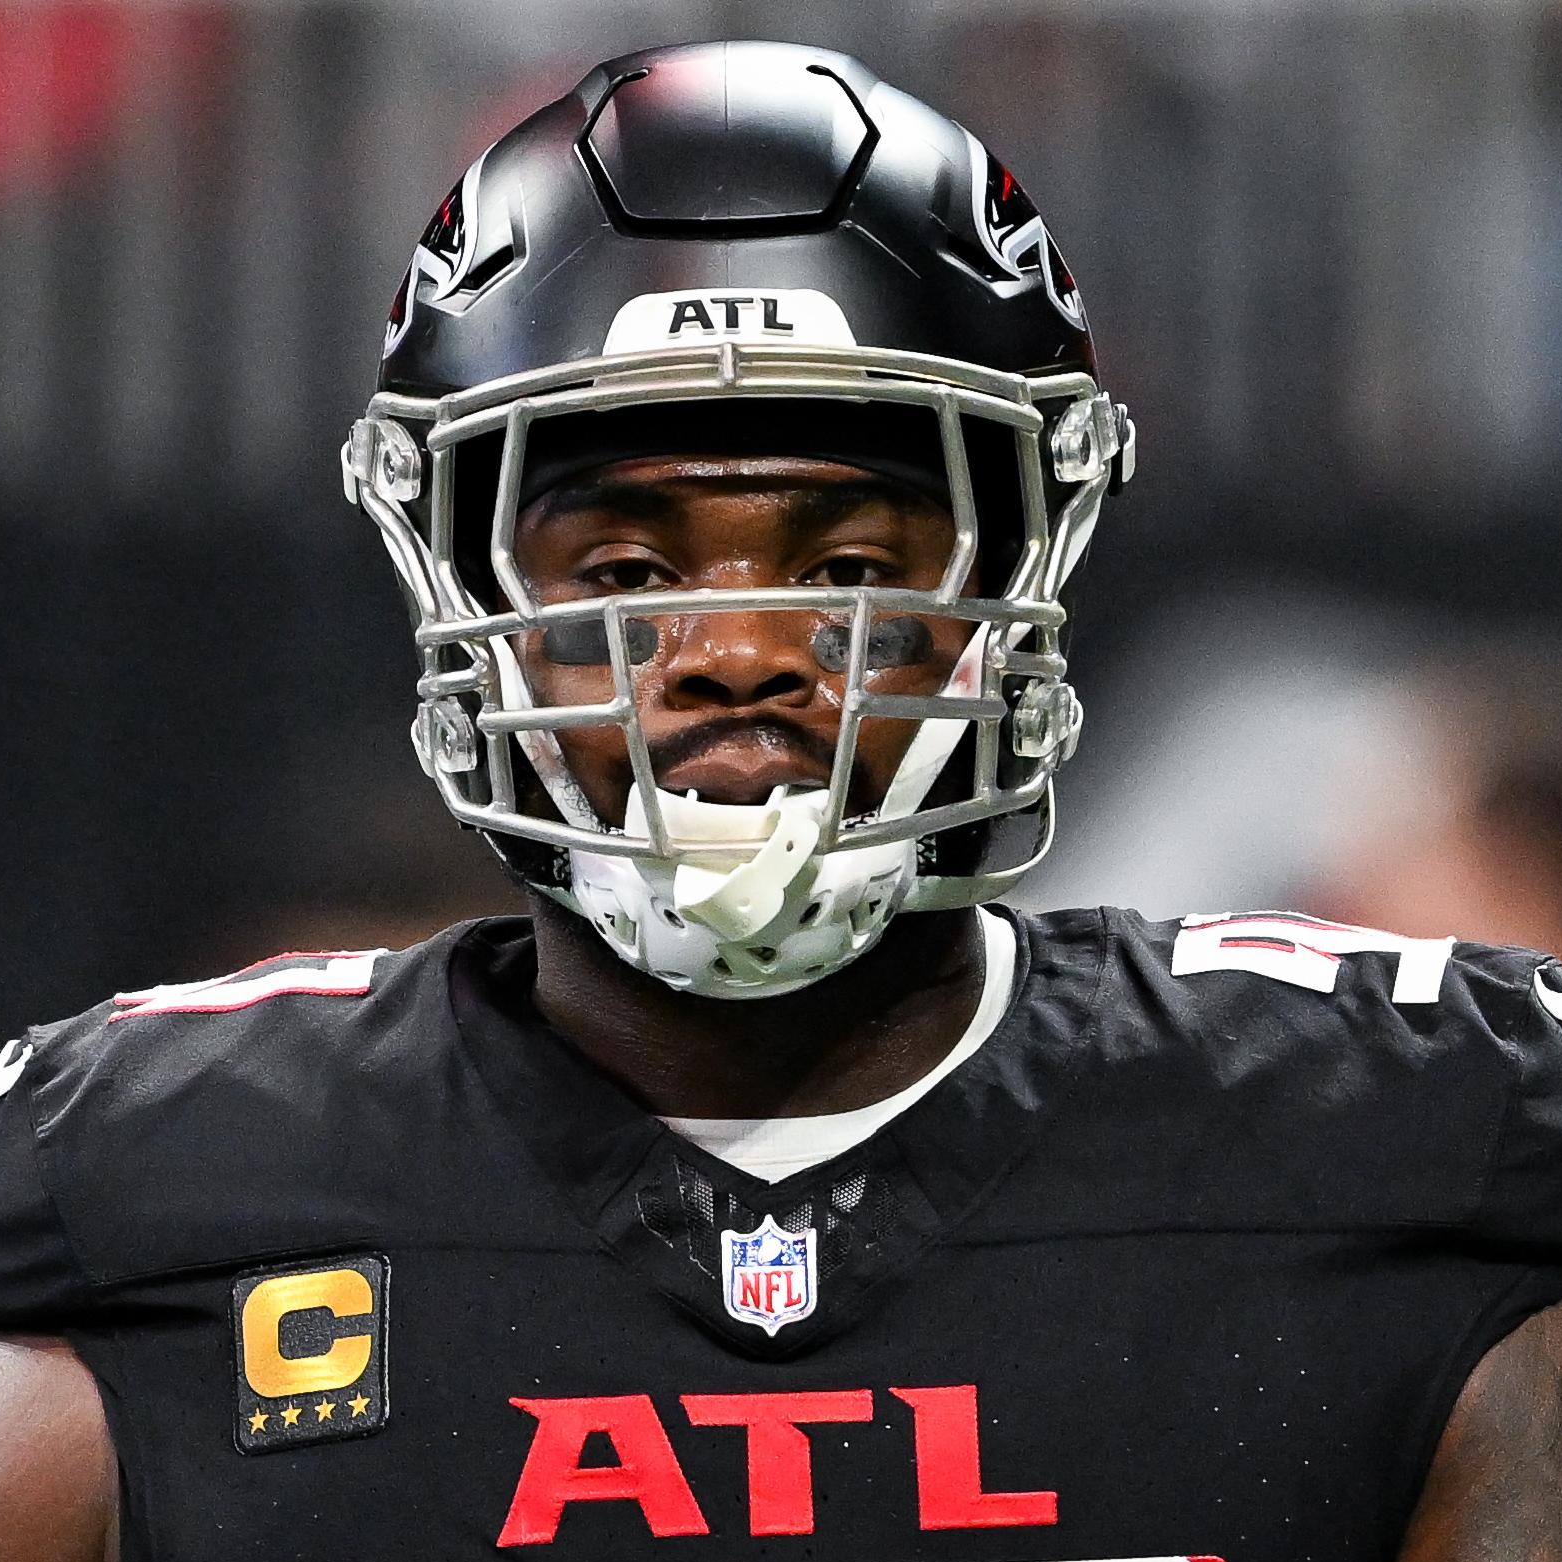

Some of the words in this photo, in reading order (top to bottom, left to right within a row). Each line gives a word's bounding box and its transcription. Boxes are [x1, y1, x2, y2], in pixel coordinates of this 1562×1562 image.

[668, 297, 794, 334] ATL
[242, 1269, 373, 1398] C
[739, 1270, 802, 1313] NFL
[496, 1385, 1058, 1547] ATL
